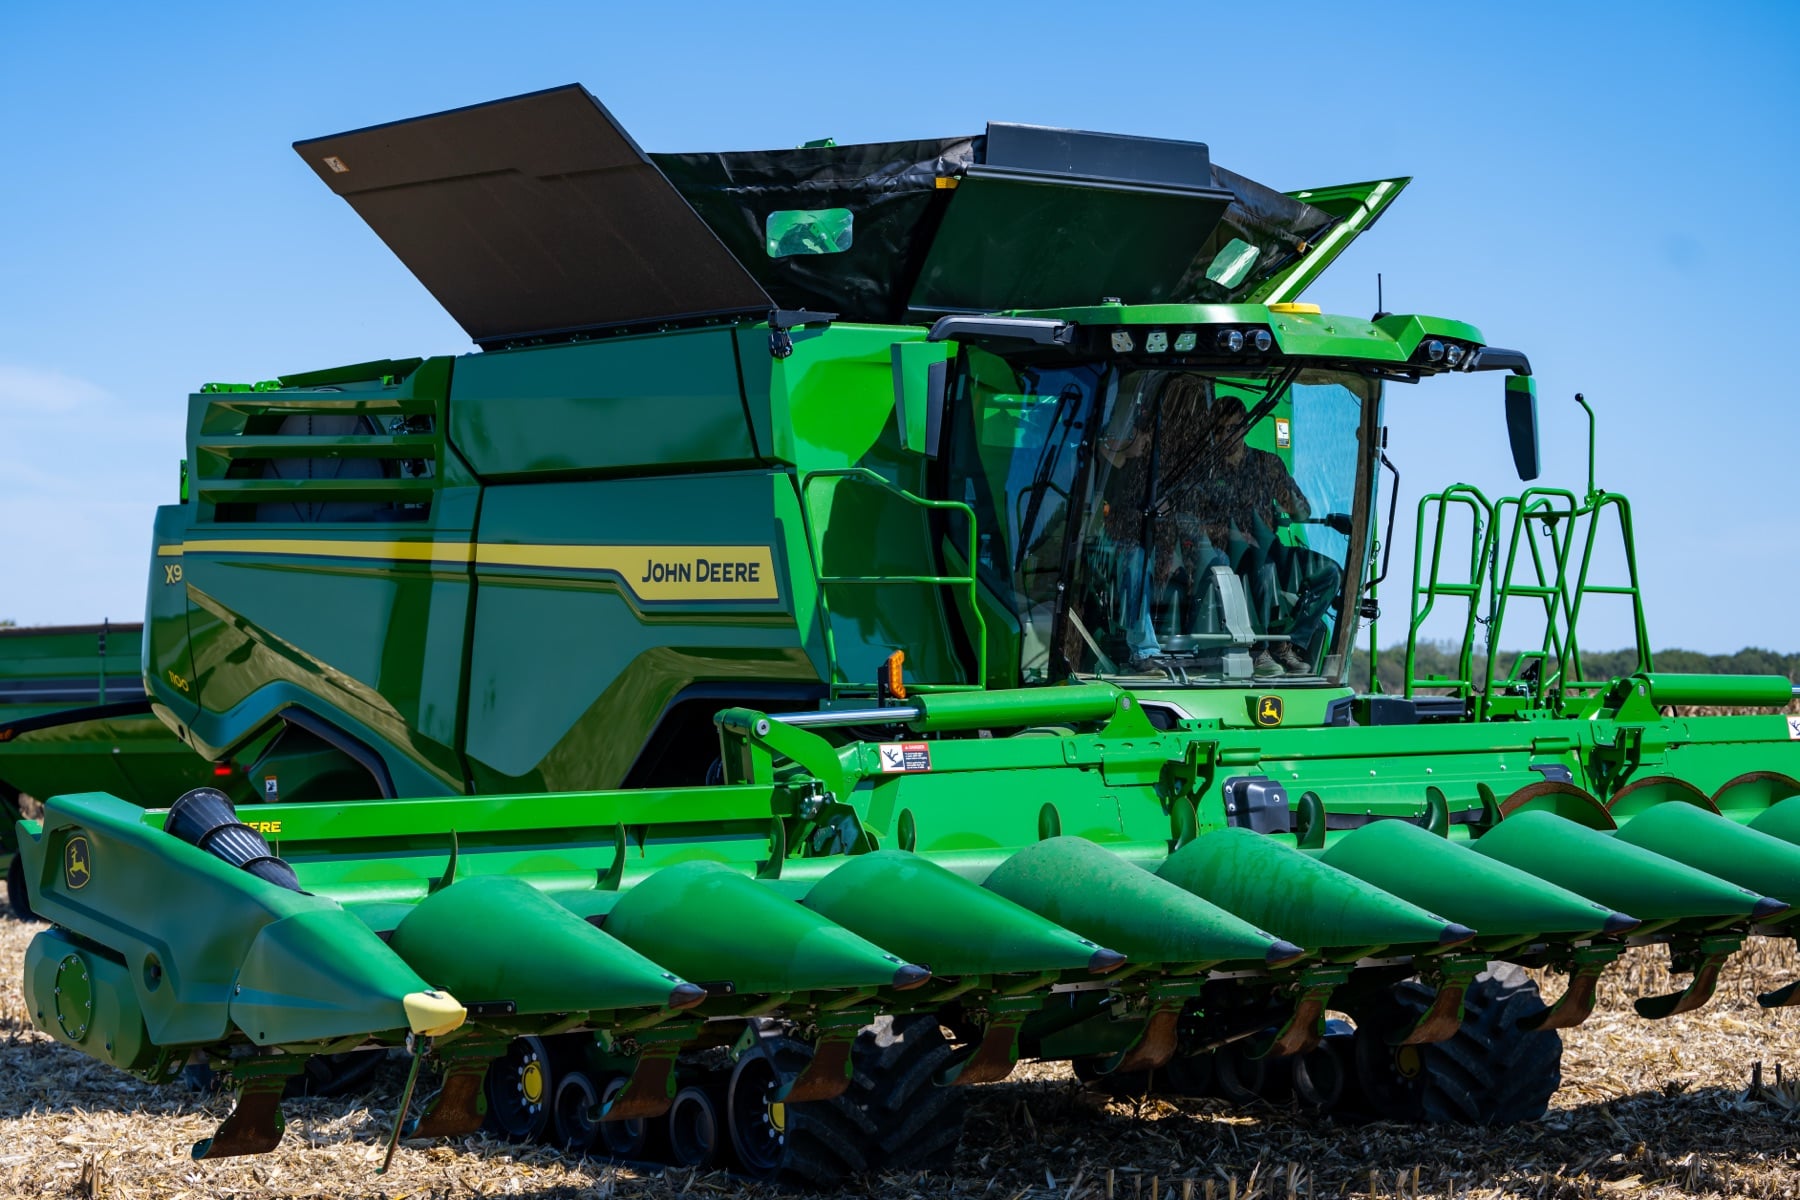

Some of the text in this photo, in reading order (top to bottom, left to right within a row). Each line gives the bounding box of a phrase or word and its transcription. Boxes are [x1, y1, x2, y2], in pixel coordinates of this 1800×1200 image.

[164, 564, 183, 584] X9
[642, 558, 761, 583] JOHN DEERE
[168, 669, 190, 692] 1100
[242, 821, 282, 833] ERE
